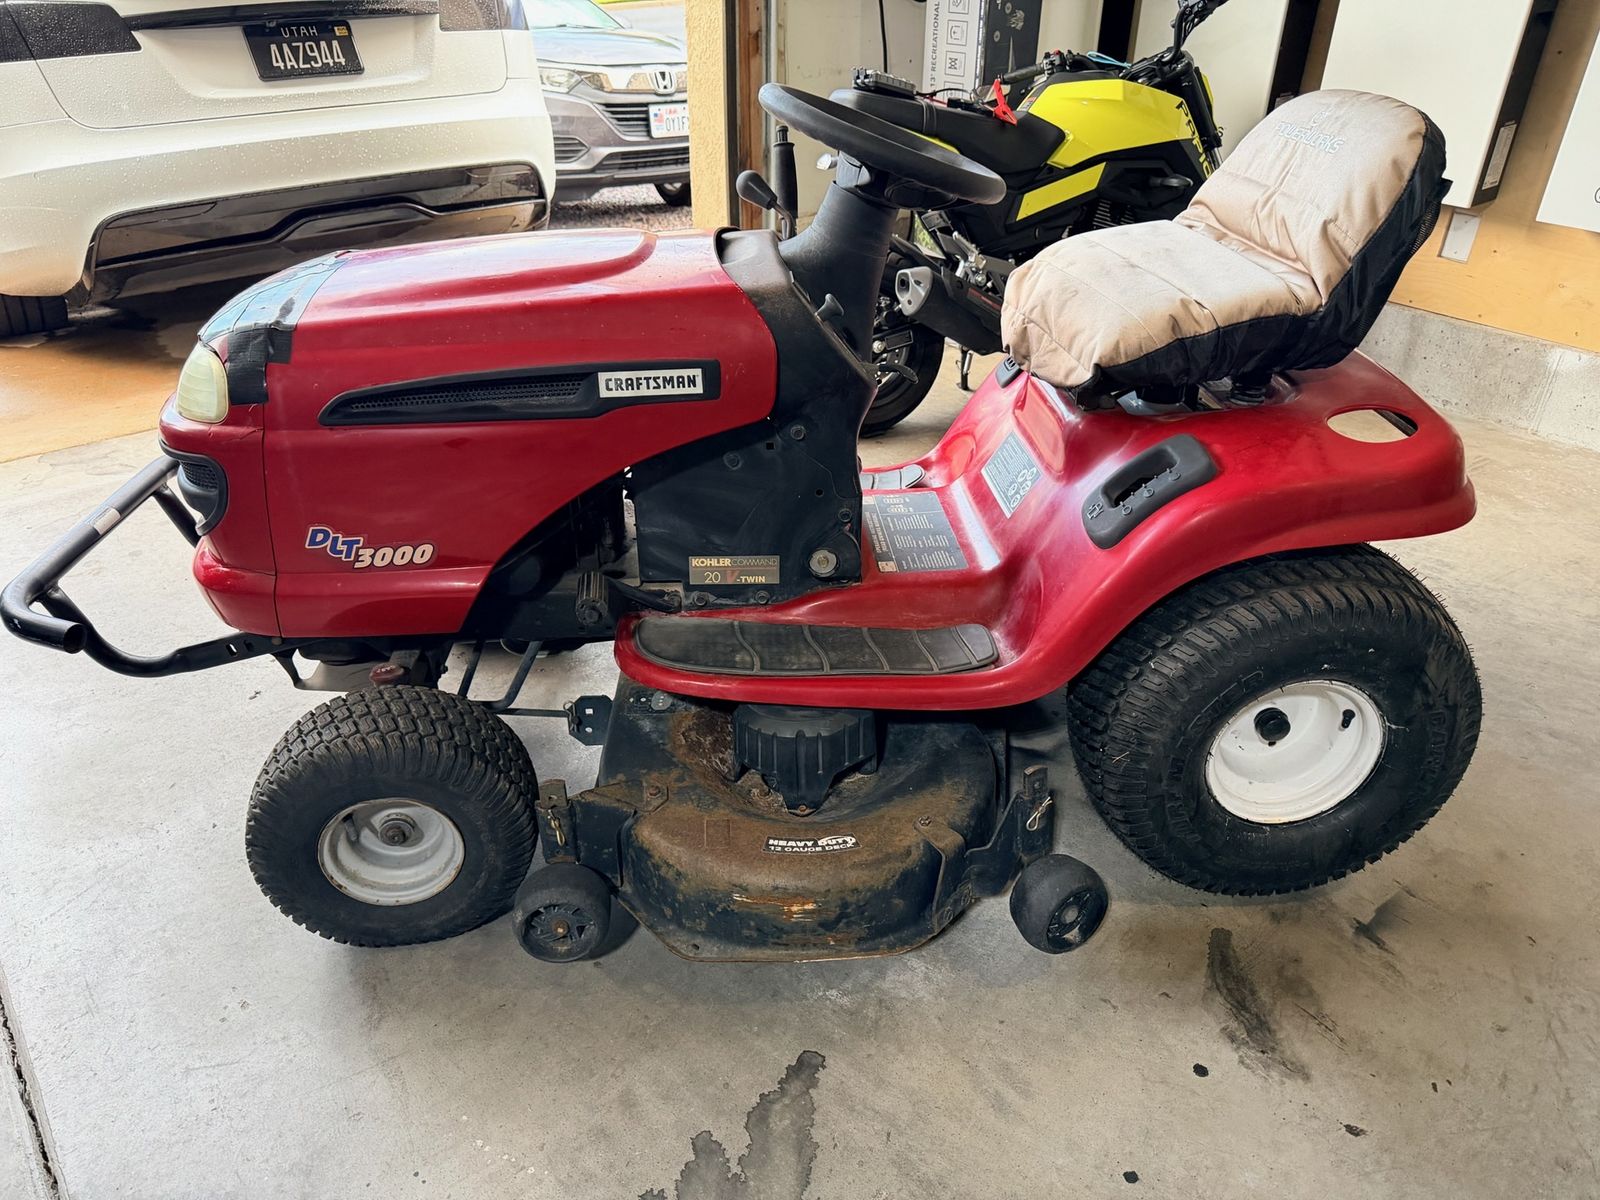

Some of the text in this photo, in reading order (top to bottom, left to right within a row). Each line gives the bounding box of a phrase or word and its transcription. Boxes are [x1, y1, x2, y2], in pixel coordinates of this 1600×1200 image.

[281, 25, 318, 38] UTAH
[930, 2, 940, 71] RECREATIONAL
[270, 40, 346, 70] 4AZ944
[604, 374, 698, 391] CRAFTSMAN
[305, 526, 434, 569] DLT 3000
[692, 558, 778, 567] KOHLER COMMAND
[704, 571, 721, 584] 20
[768, 836, 856, 847] HEAVY DUTY
[825, 843, 855, 851] DECK
